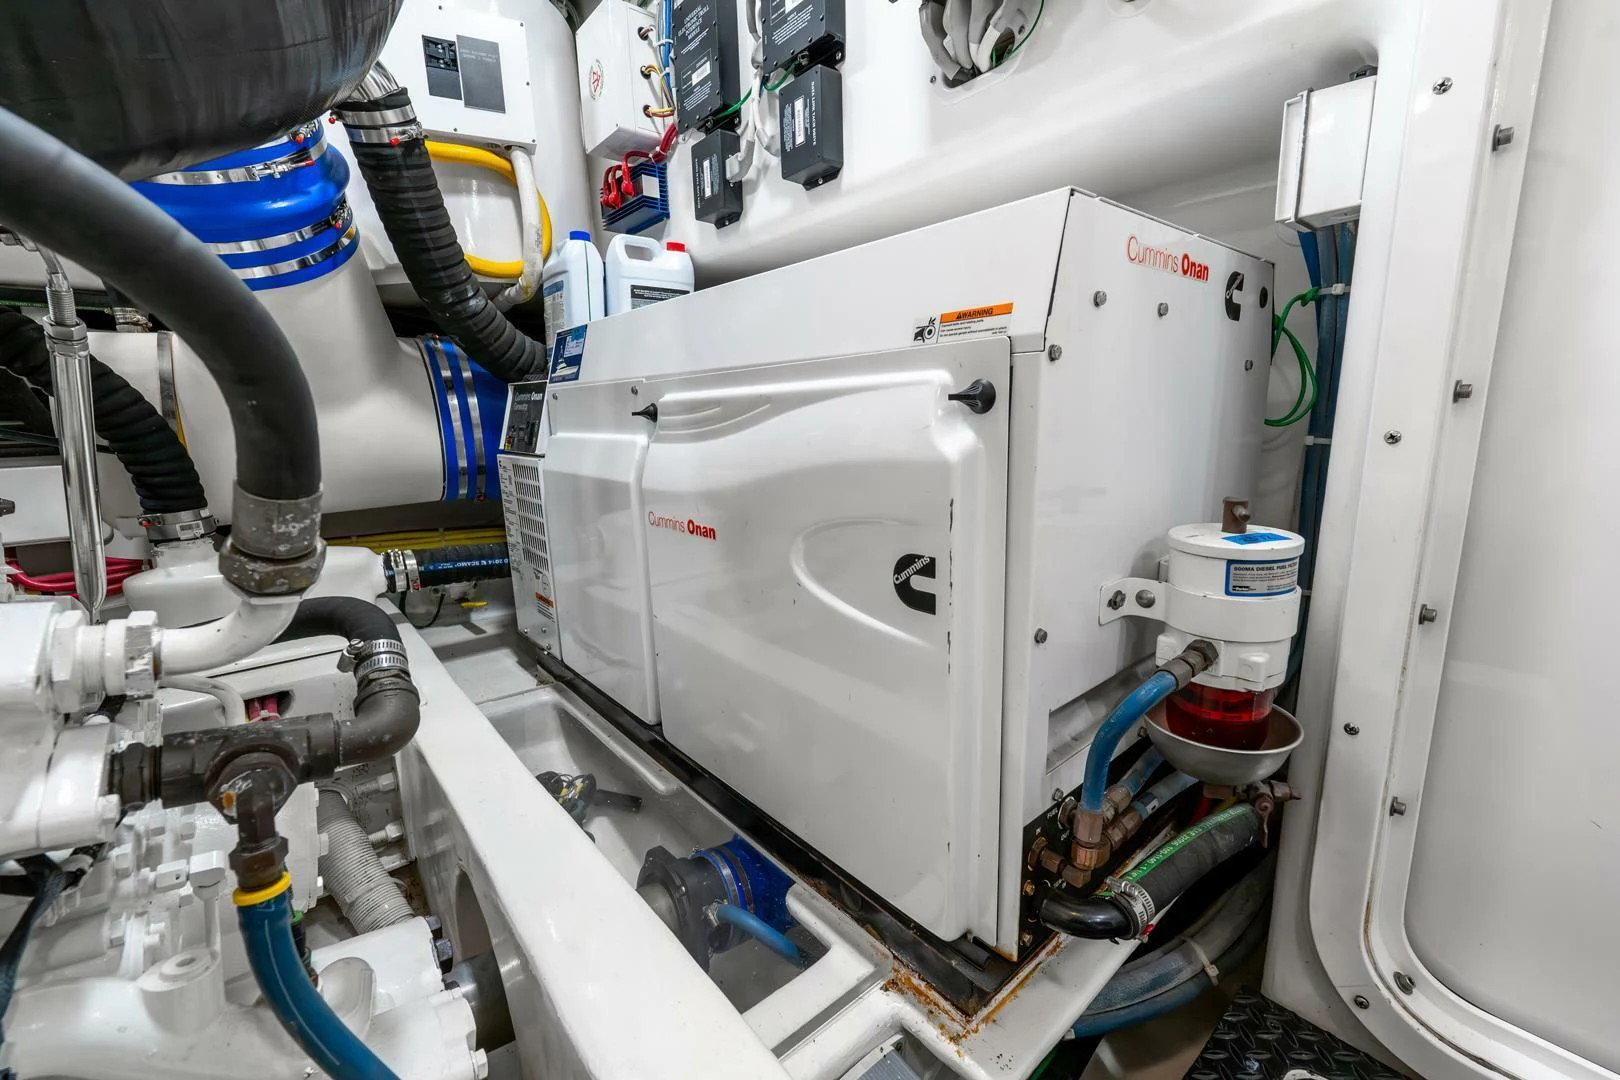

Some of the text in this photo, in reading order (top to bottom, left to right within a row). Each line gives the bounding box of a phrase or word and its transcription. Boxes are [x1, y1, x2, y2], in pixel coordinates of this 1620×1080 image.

[1127, 235, 1210, 281] Cummins Onan
[960, 307, 994, 319] WARNING
[648, 511, 717, 541] Cummins Onan
[893, 556, 931, 585] Cummins
